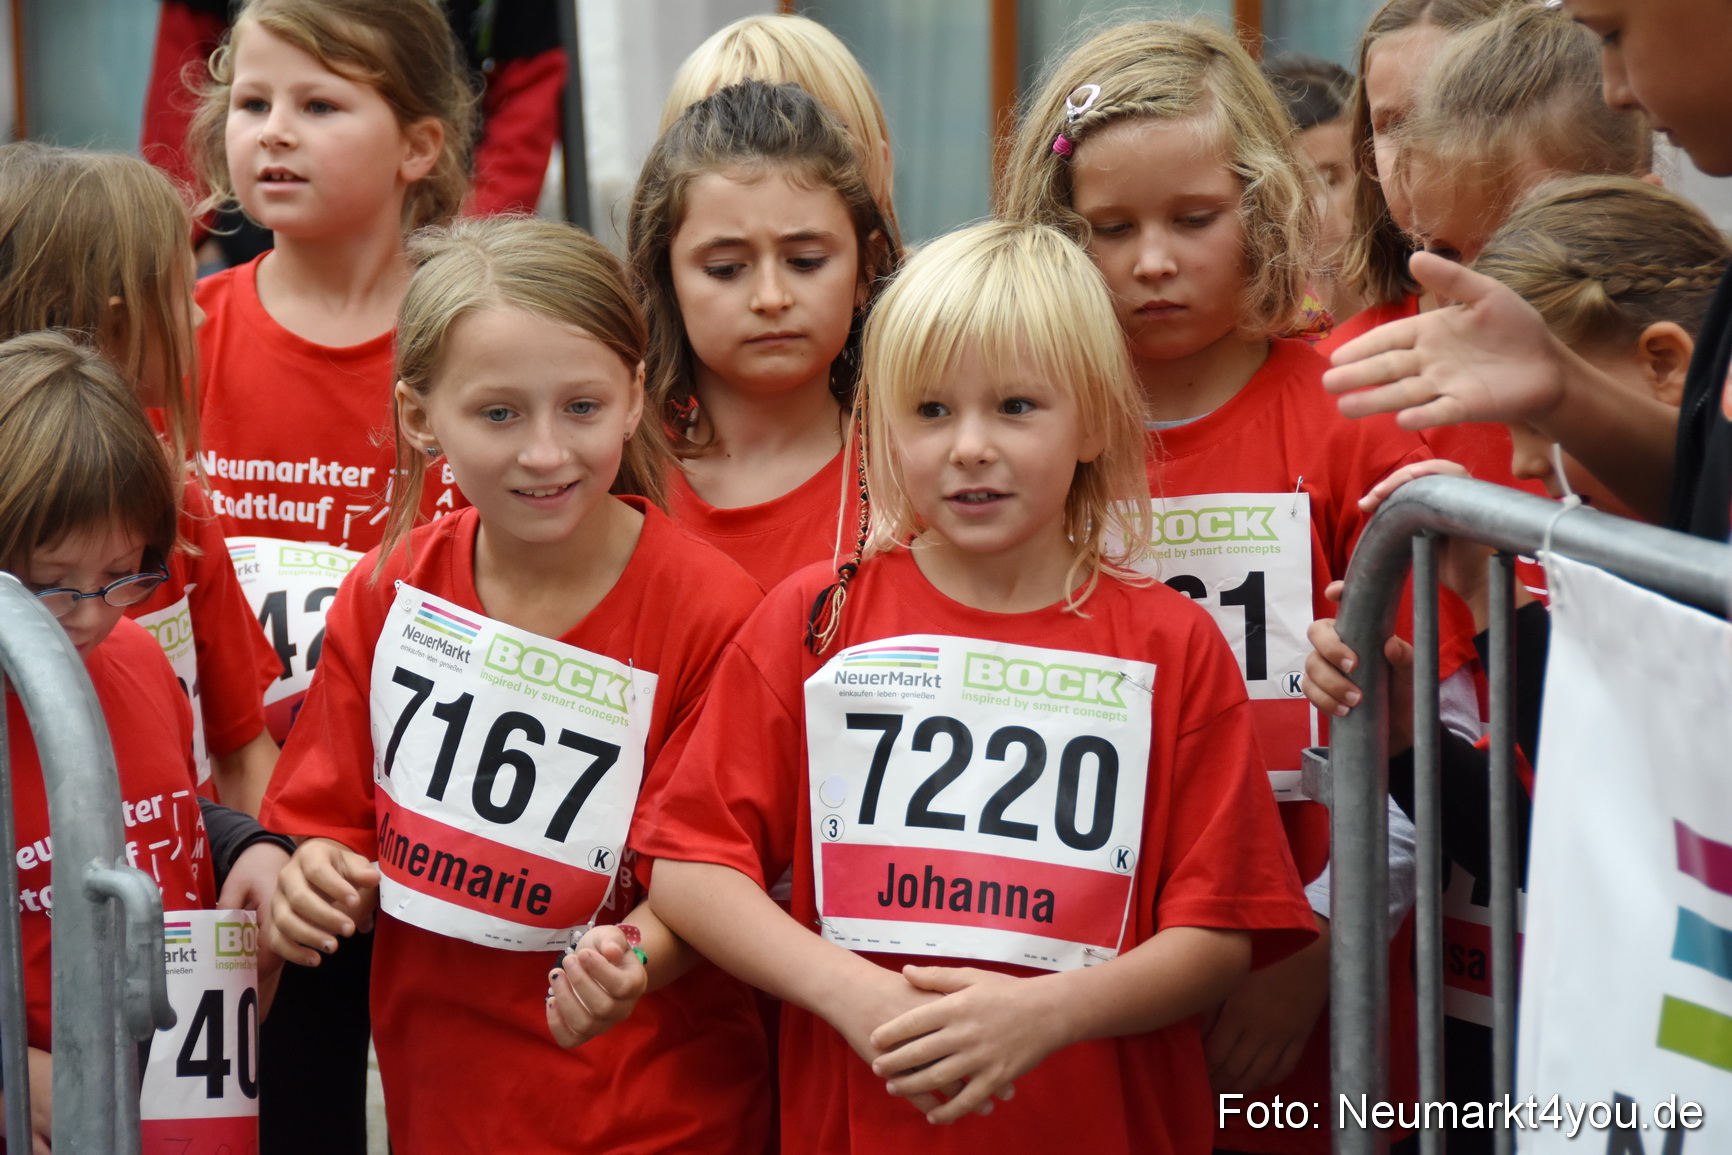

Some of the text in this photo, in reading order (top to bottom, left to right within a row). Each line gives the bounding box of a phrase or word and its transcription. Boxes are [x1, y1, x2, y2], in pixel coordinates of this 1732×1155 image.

[195, 450, 376, 488] Neumarkter
[205, 490, 335, 530] tadtlauf
[1174, 548, 1188, 559] by
[1190, 546, 1223, 557] smart
[1226, 544, 1281, 556] concepts
[402, 624, 471, 664] NeuerMarkt
[484, 633, 632, 715] BOCK
[834, 670, 942, 689] NeuerMarkt
[964, 651, 1128, 709] BOCK
[1289, 674, 1302, 693] K
[480, 669, 630, 728] inspired by smart concepts
[839, 690, 935, 701] einkaufen leben genießen
[961, 691, 1128, 722] inspired by smart concepts
[384, 666, 622, 843] 7167
[846, 712, 1119, 851] 7220
[828, 818, 838, 838] 3
[378, 812, 552, 916] Annemarie
[594, 849, 609, 869] K
[1117, 848, 1129, 869] K
[877, 862, 1055, 924] Johanna
